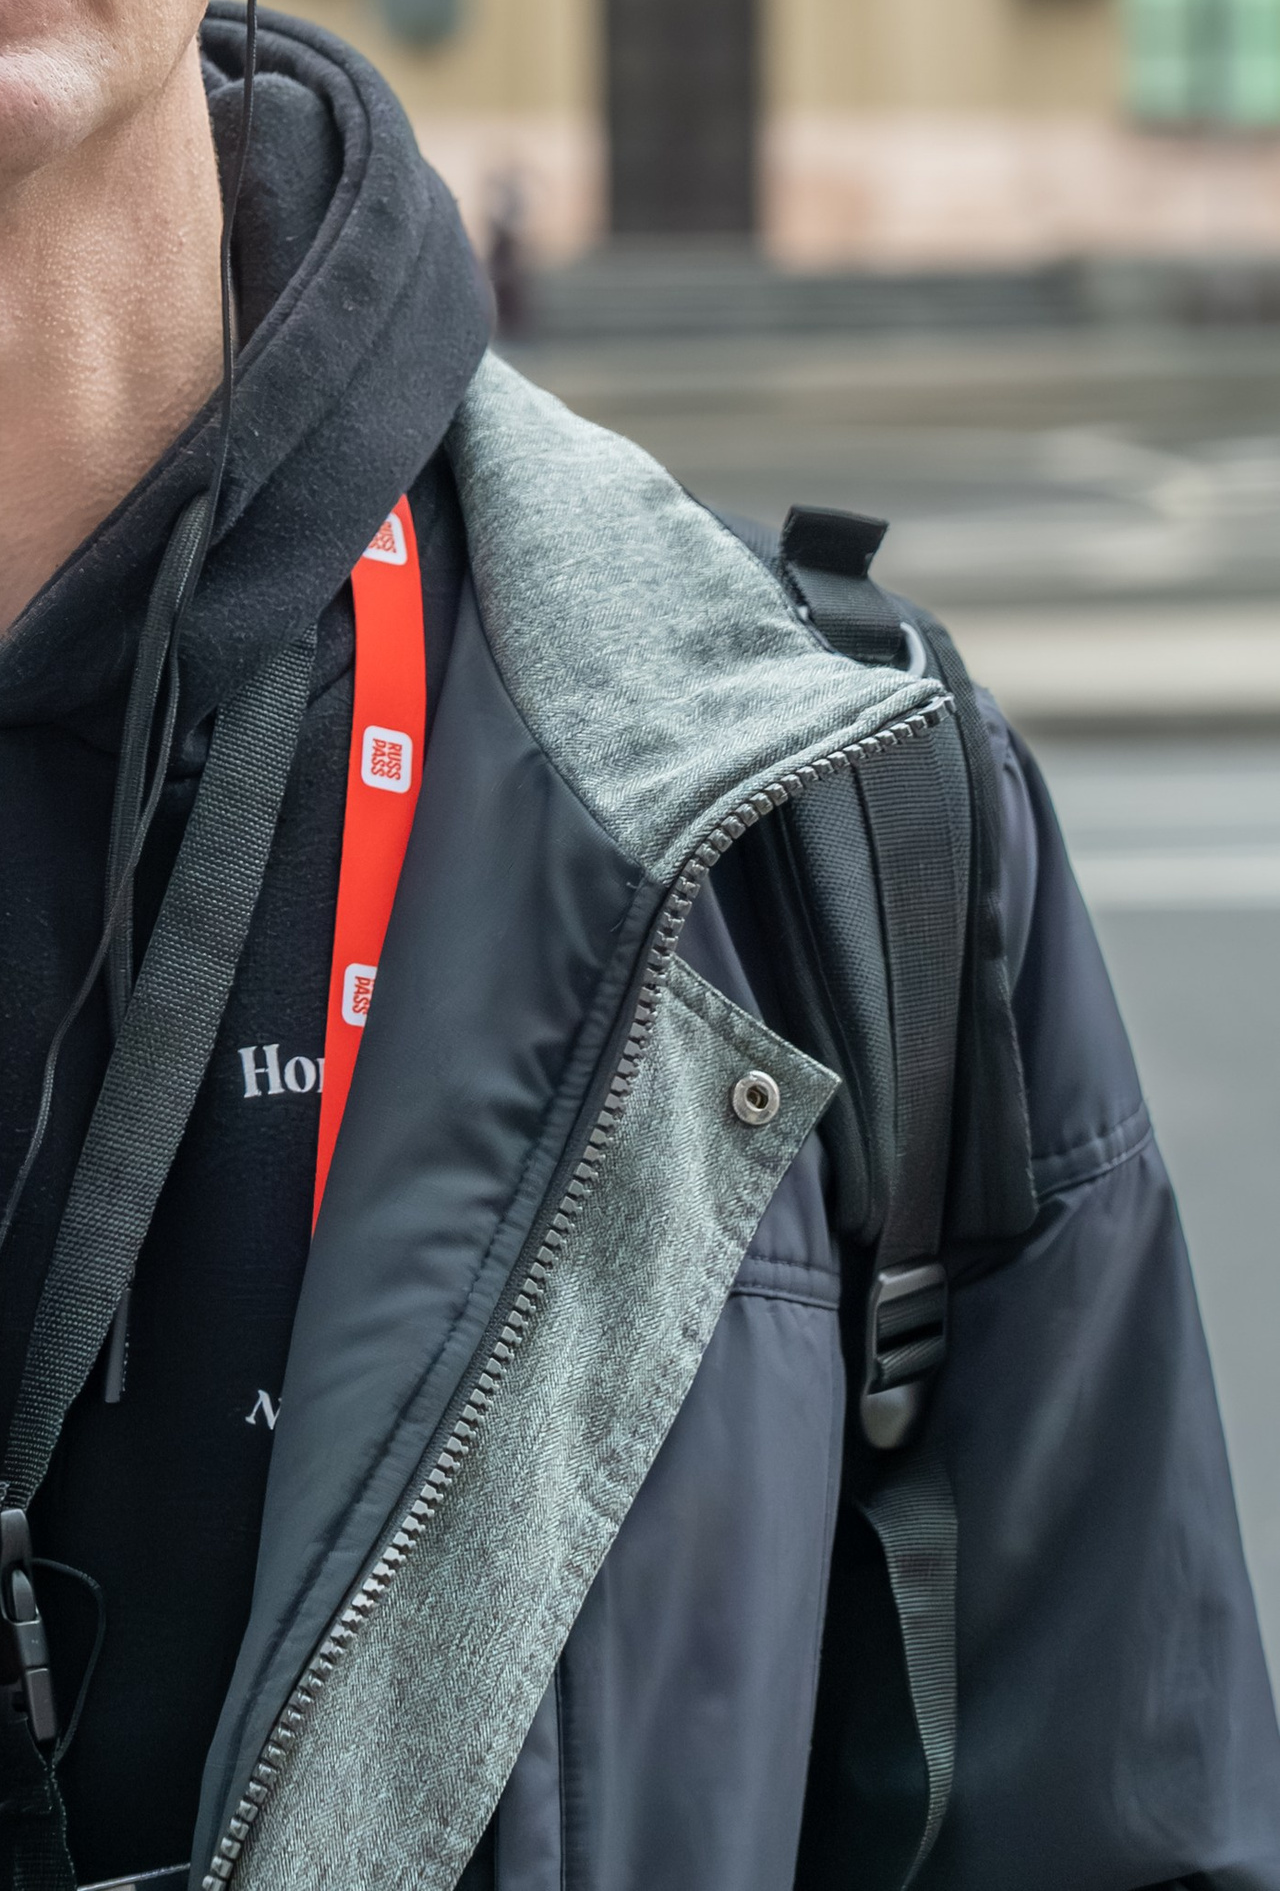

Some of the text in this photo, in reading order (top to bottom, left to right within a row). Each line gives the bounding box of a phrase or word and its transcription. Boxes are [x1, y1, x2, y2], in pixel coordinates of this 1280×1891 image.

[371, 738, 387, 777] PASS
[387, 741, 403, 781] RUSS
[352, 976, 371, 1015] PASS
[237, 1043, 325, 1099] Ho
